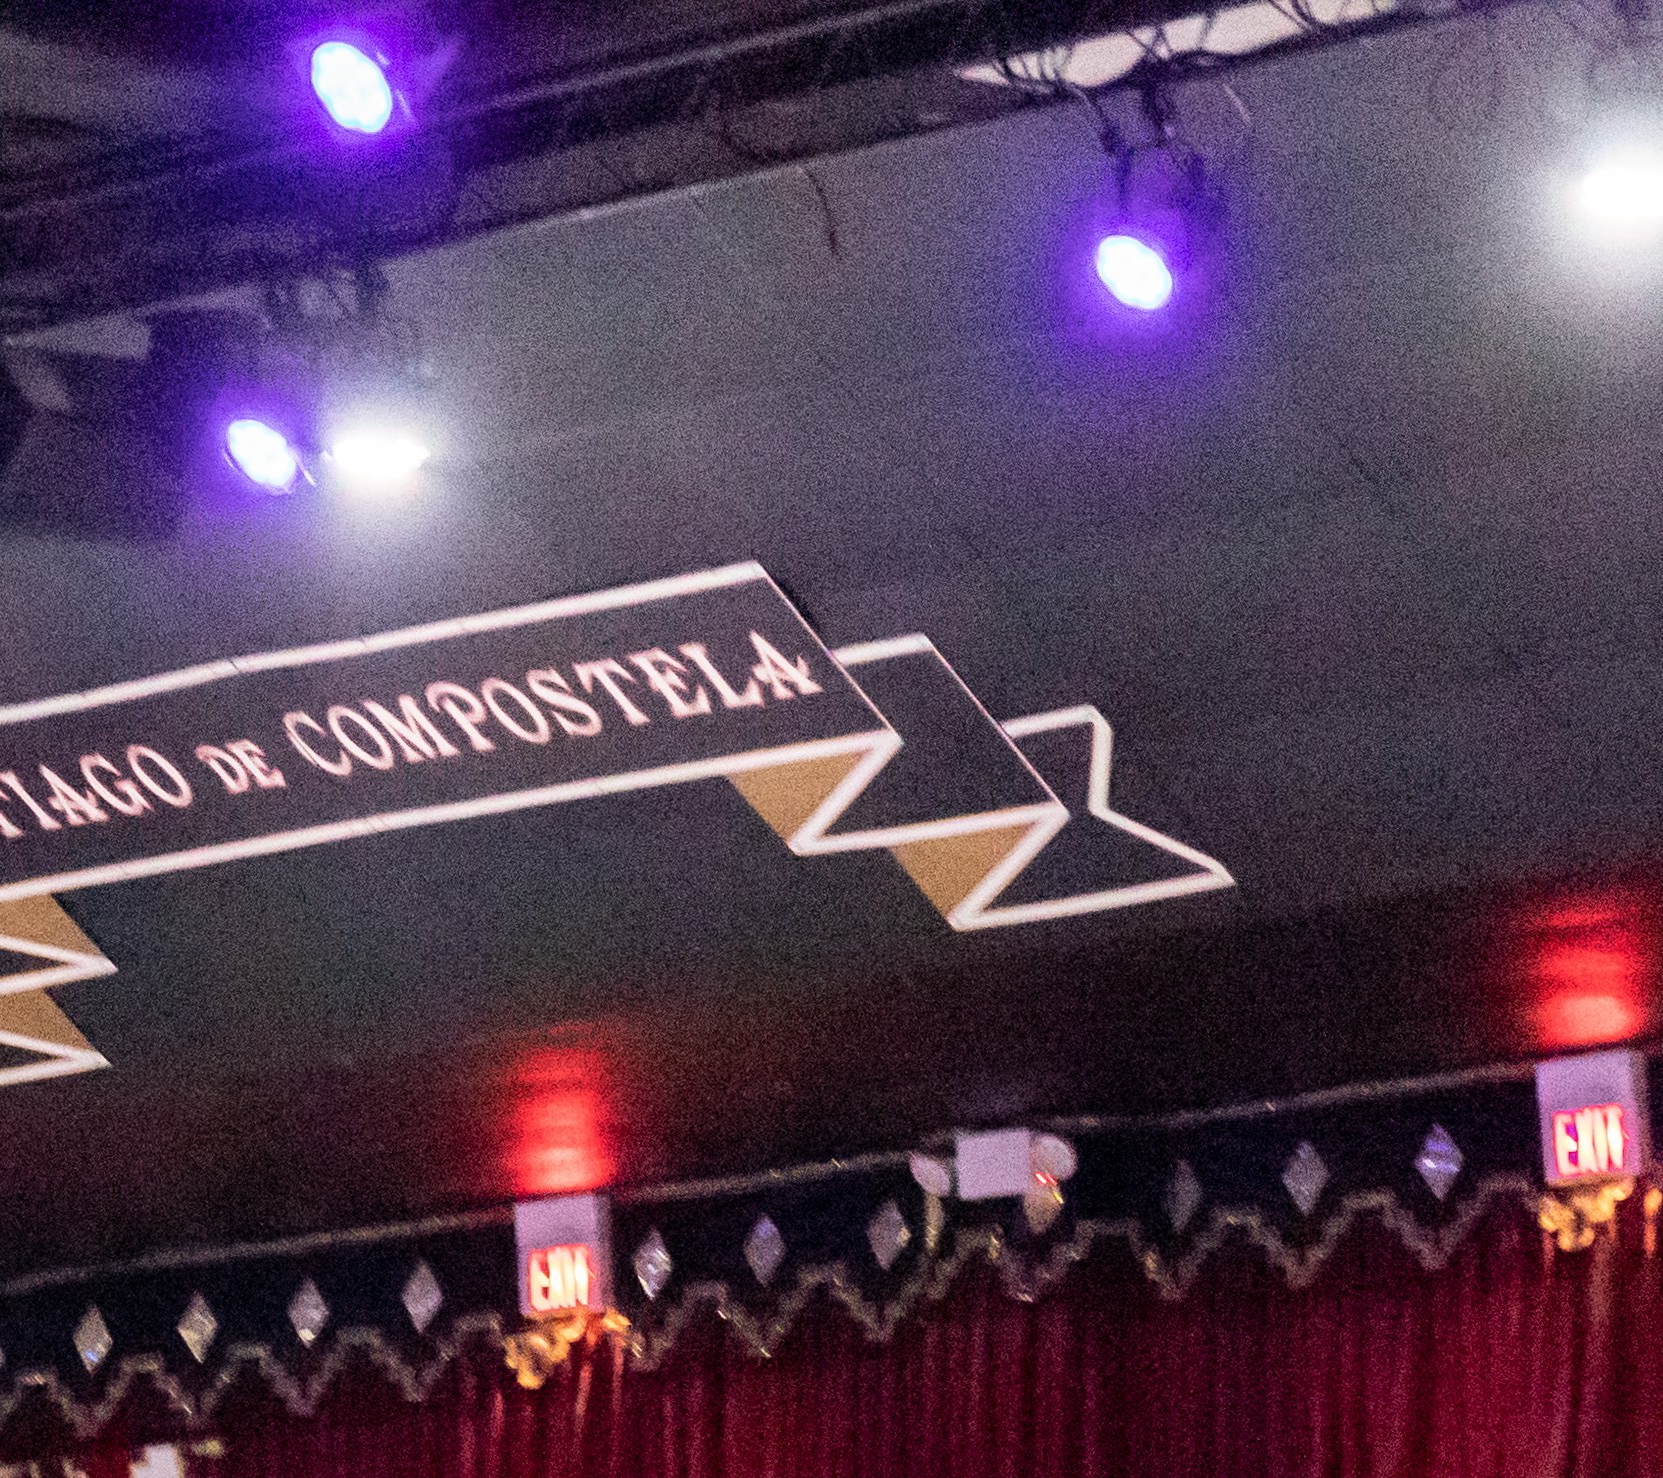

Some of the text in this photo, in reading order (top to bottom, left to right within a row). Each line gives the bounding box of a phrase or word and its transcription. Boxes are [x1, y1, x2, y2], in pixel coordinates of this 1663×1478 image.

[194, 737, 287, 796] DE
[281, 629, 824, 778] COMPOSTELA
[1554, 1104, 1626, 1175] EXIT
